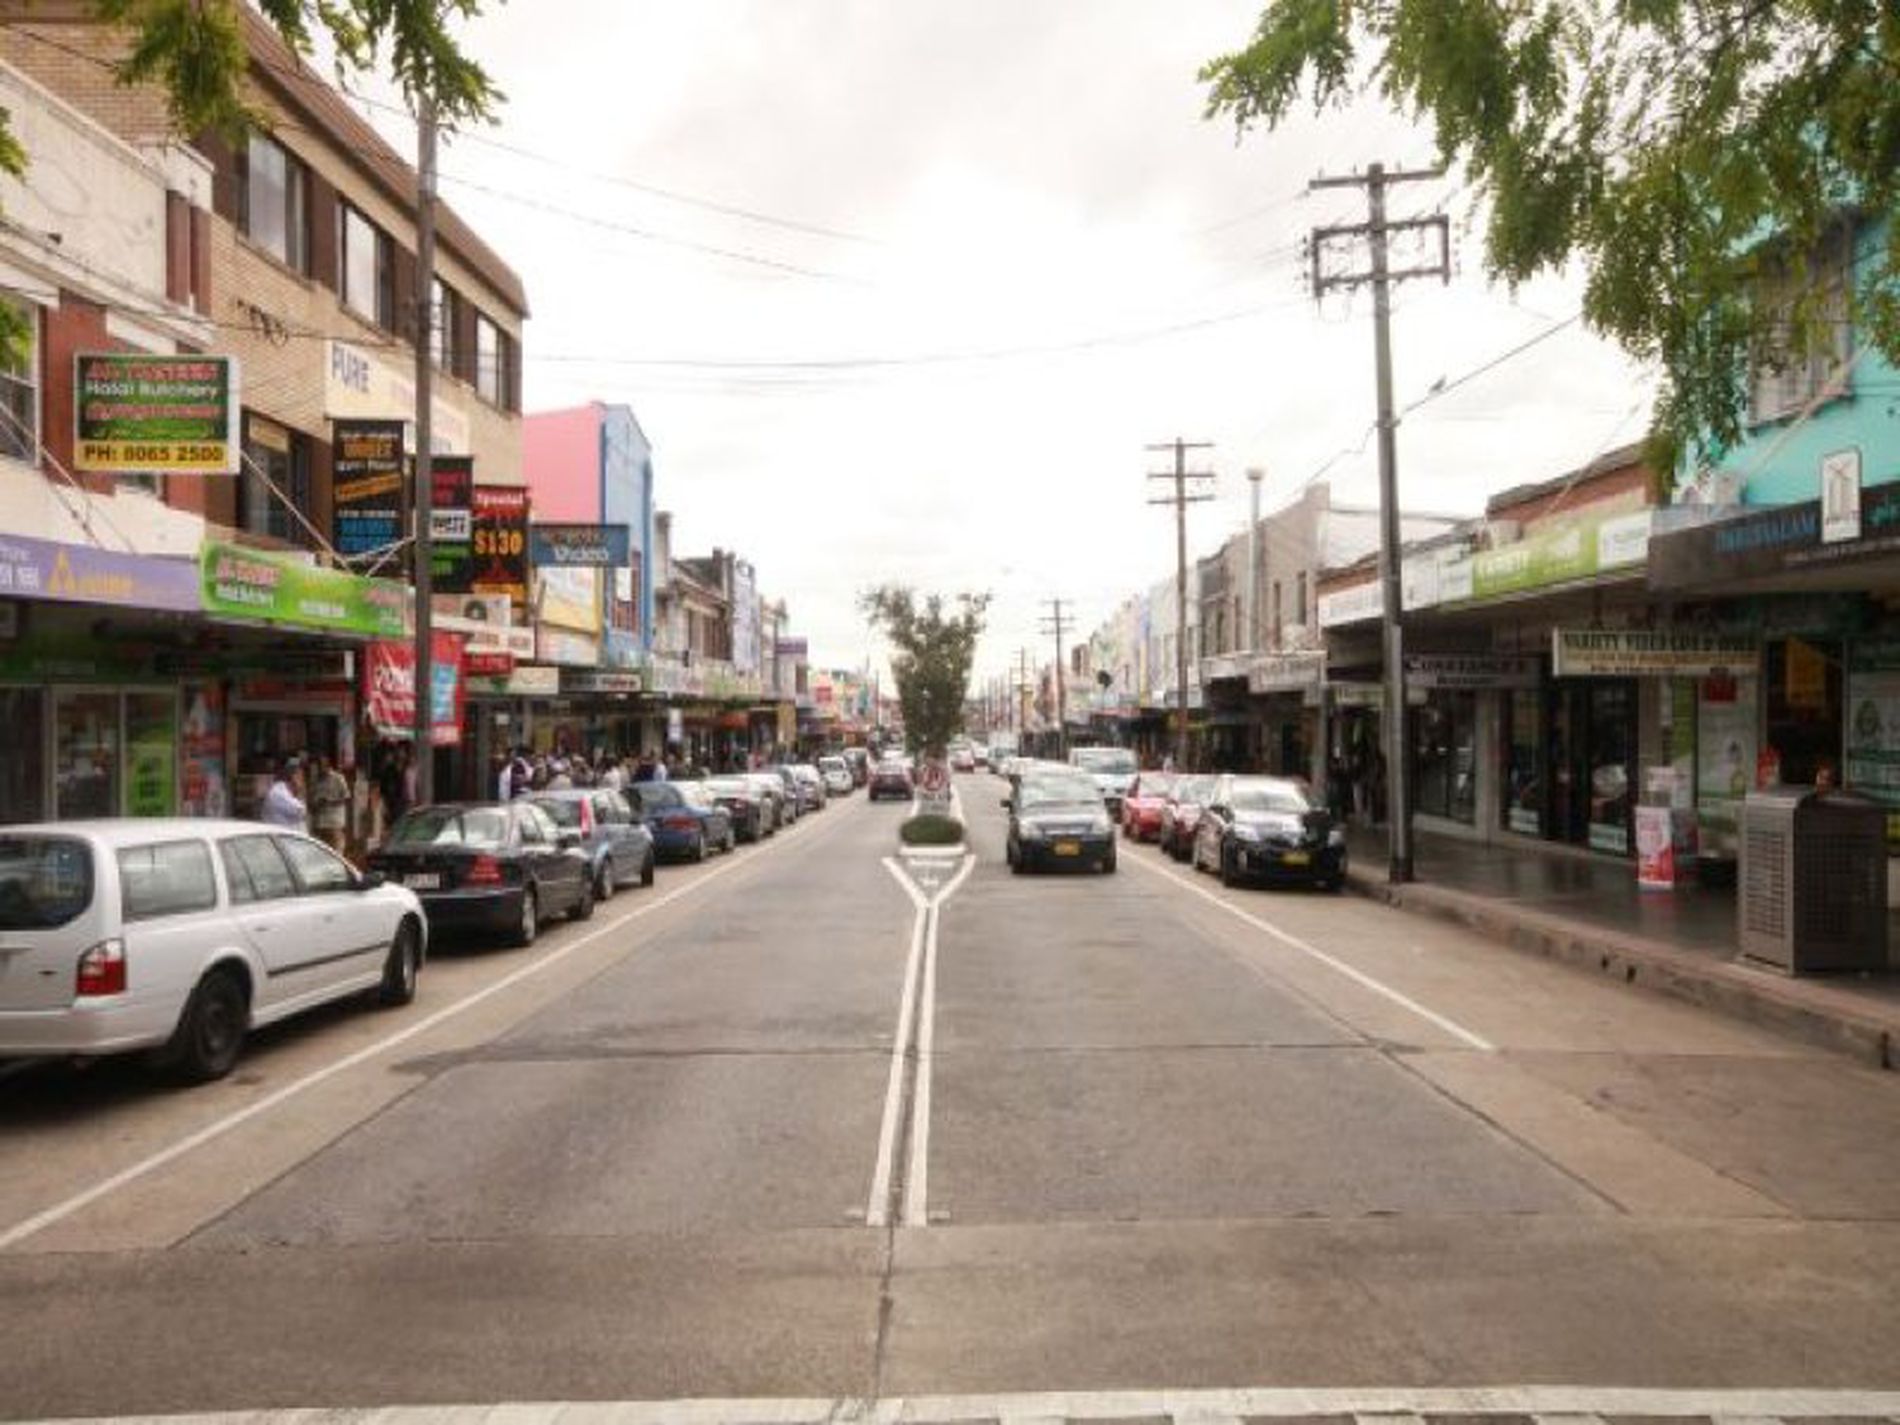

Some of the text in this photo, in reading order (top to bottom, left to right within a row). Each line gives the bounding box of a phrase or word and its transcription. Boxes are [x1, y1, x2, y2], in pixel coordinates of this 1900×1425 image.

[332, 343, 369, 393] PURE
[138, 382, 217, 399] Butchery
[84, 444, 117, 461] PH:
